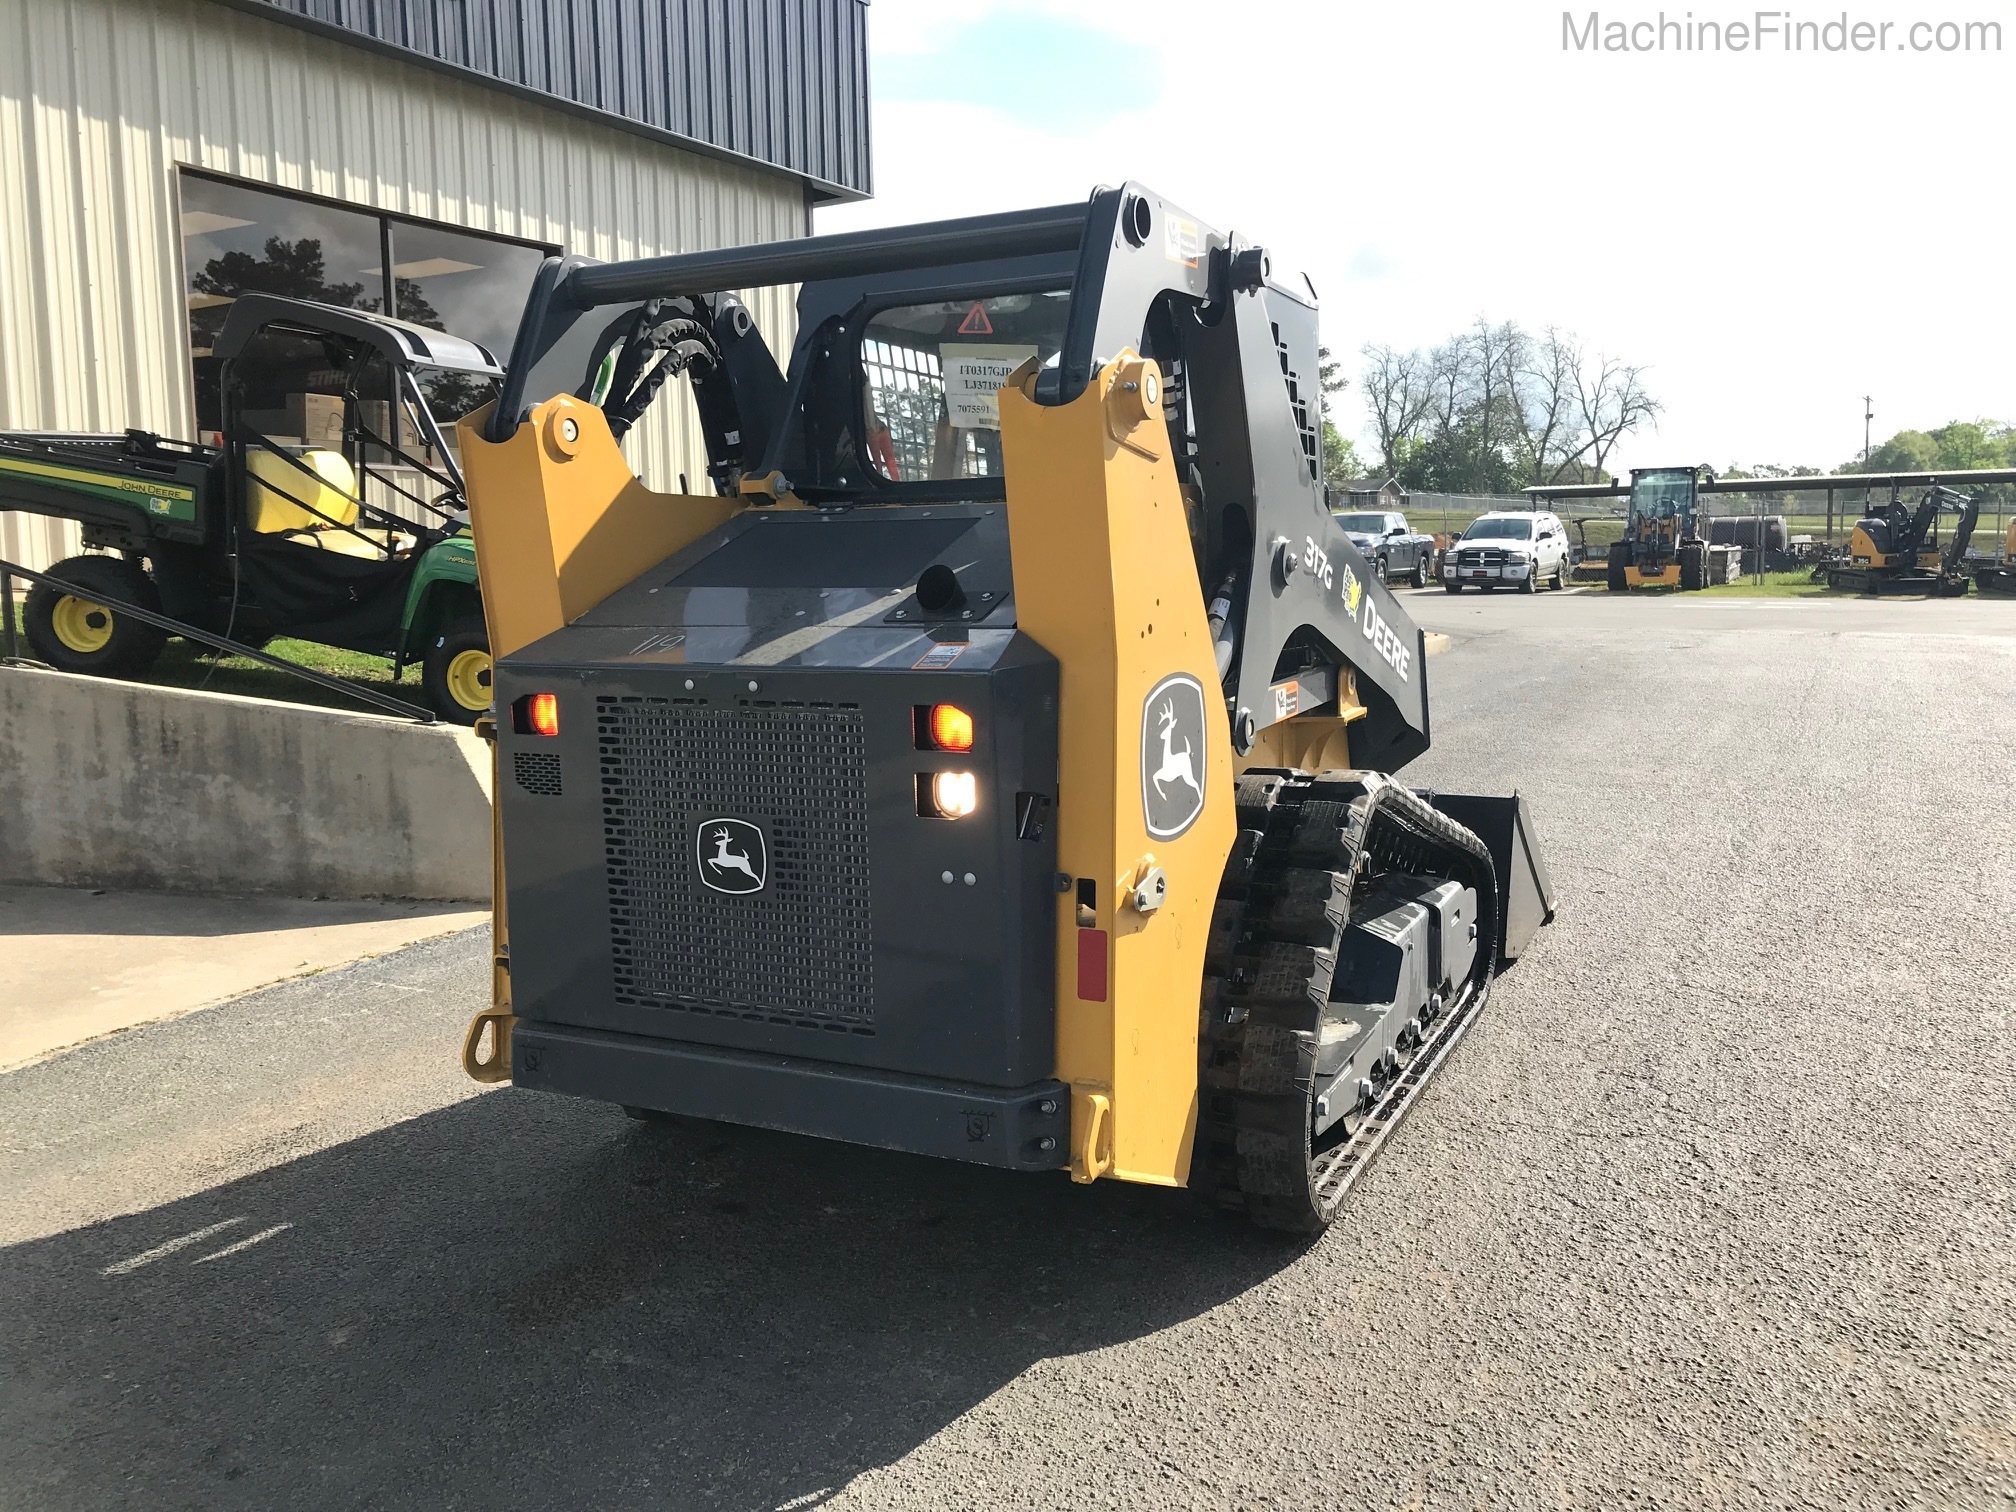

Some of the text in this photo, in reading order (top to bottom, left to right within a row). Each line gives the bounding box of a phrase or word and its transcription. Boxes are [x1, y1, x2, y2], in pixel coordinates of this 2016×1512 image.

[957, 404, 990, 414] 7075591
[117, 480, 182, 498] JOHN DEERE
[1304, 535, 1334, 590] 317G
[1362, 593, 1411, 683] DEERE
